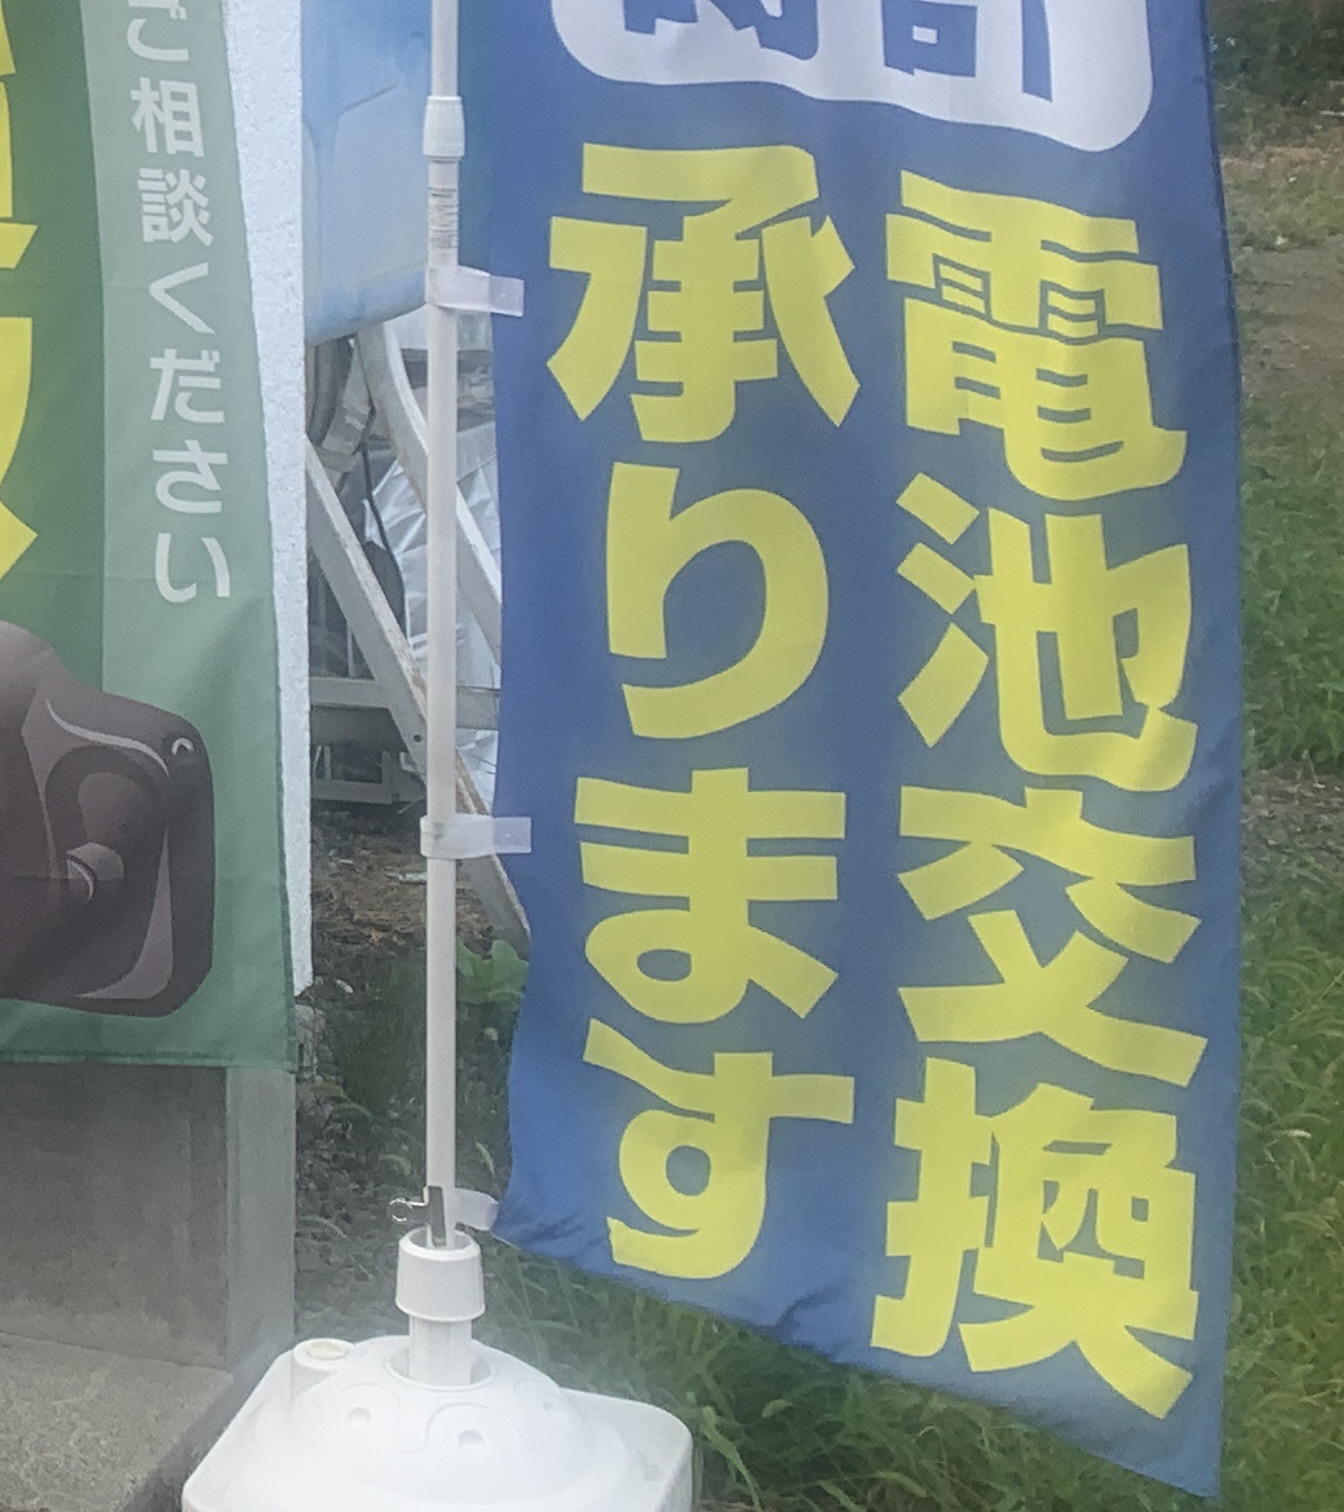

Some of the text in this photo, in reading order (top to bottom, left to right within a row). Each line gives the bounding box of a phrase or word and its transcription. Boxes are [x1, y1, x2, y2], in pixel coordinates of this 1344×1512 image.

[547, 143, 860, 1281] 承ります
[870, 170, 1208, 1421] 電池交換
